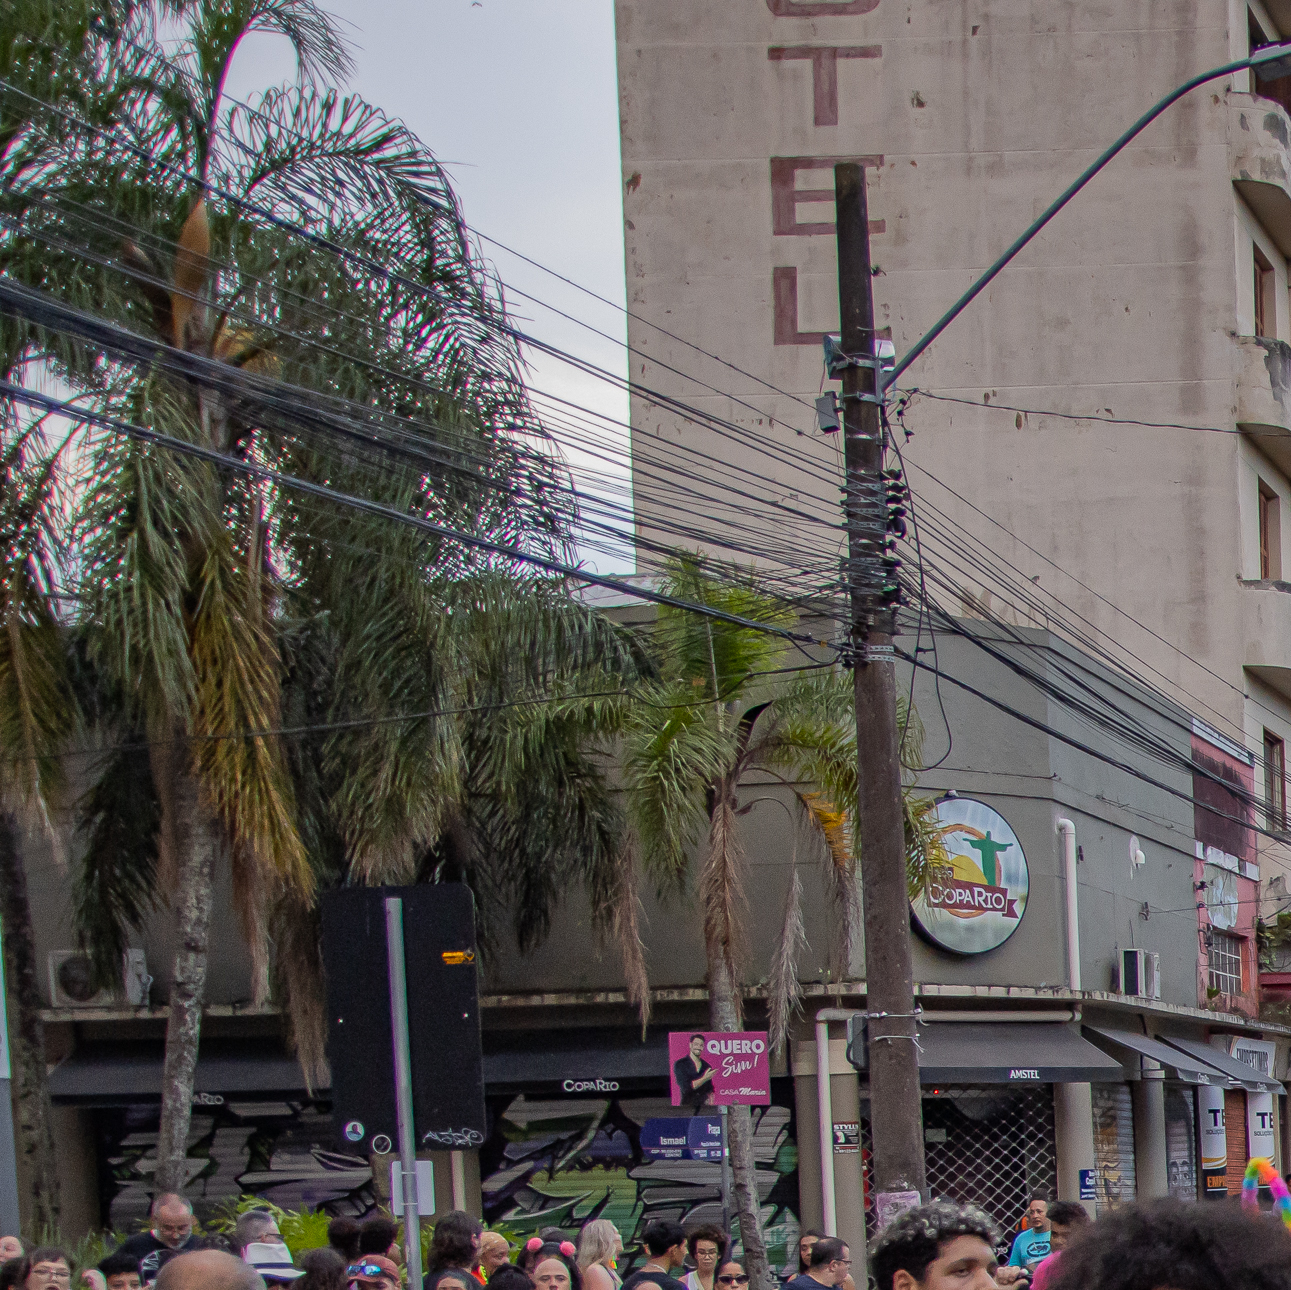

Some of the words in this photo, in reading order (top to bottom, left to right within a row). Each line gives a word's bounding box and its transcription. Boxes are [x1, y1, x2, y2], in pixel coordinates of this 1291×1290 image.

[766, 0, 892, 345] TEL
[706, 1039, 765, 1055] QUERO
[1009, 1069, 1040, 1079] AMSTEL
[660, 1136, 686, 1145] Ismael
